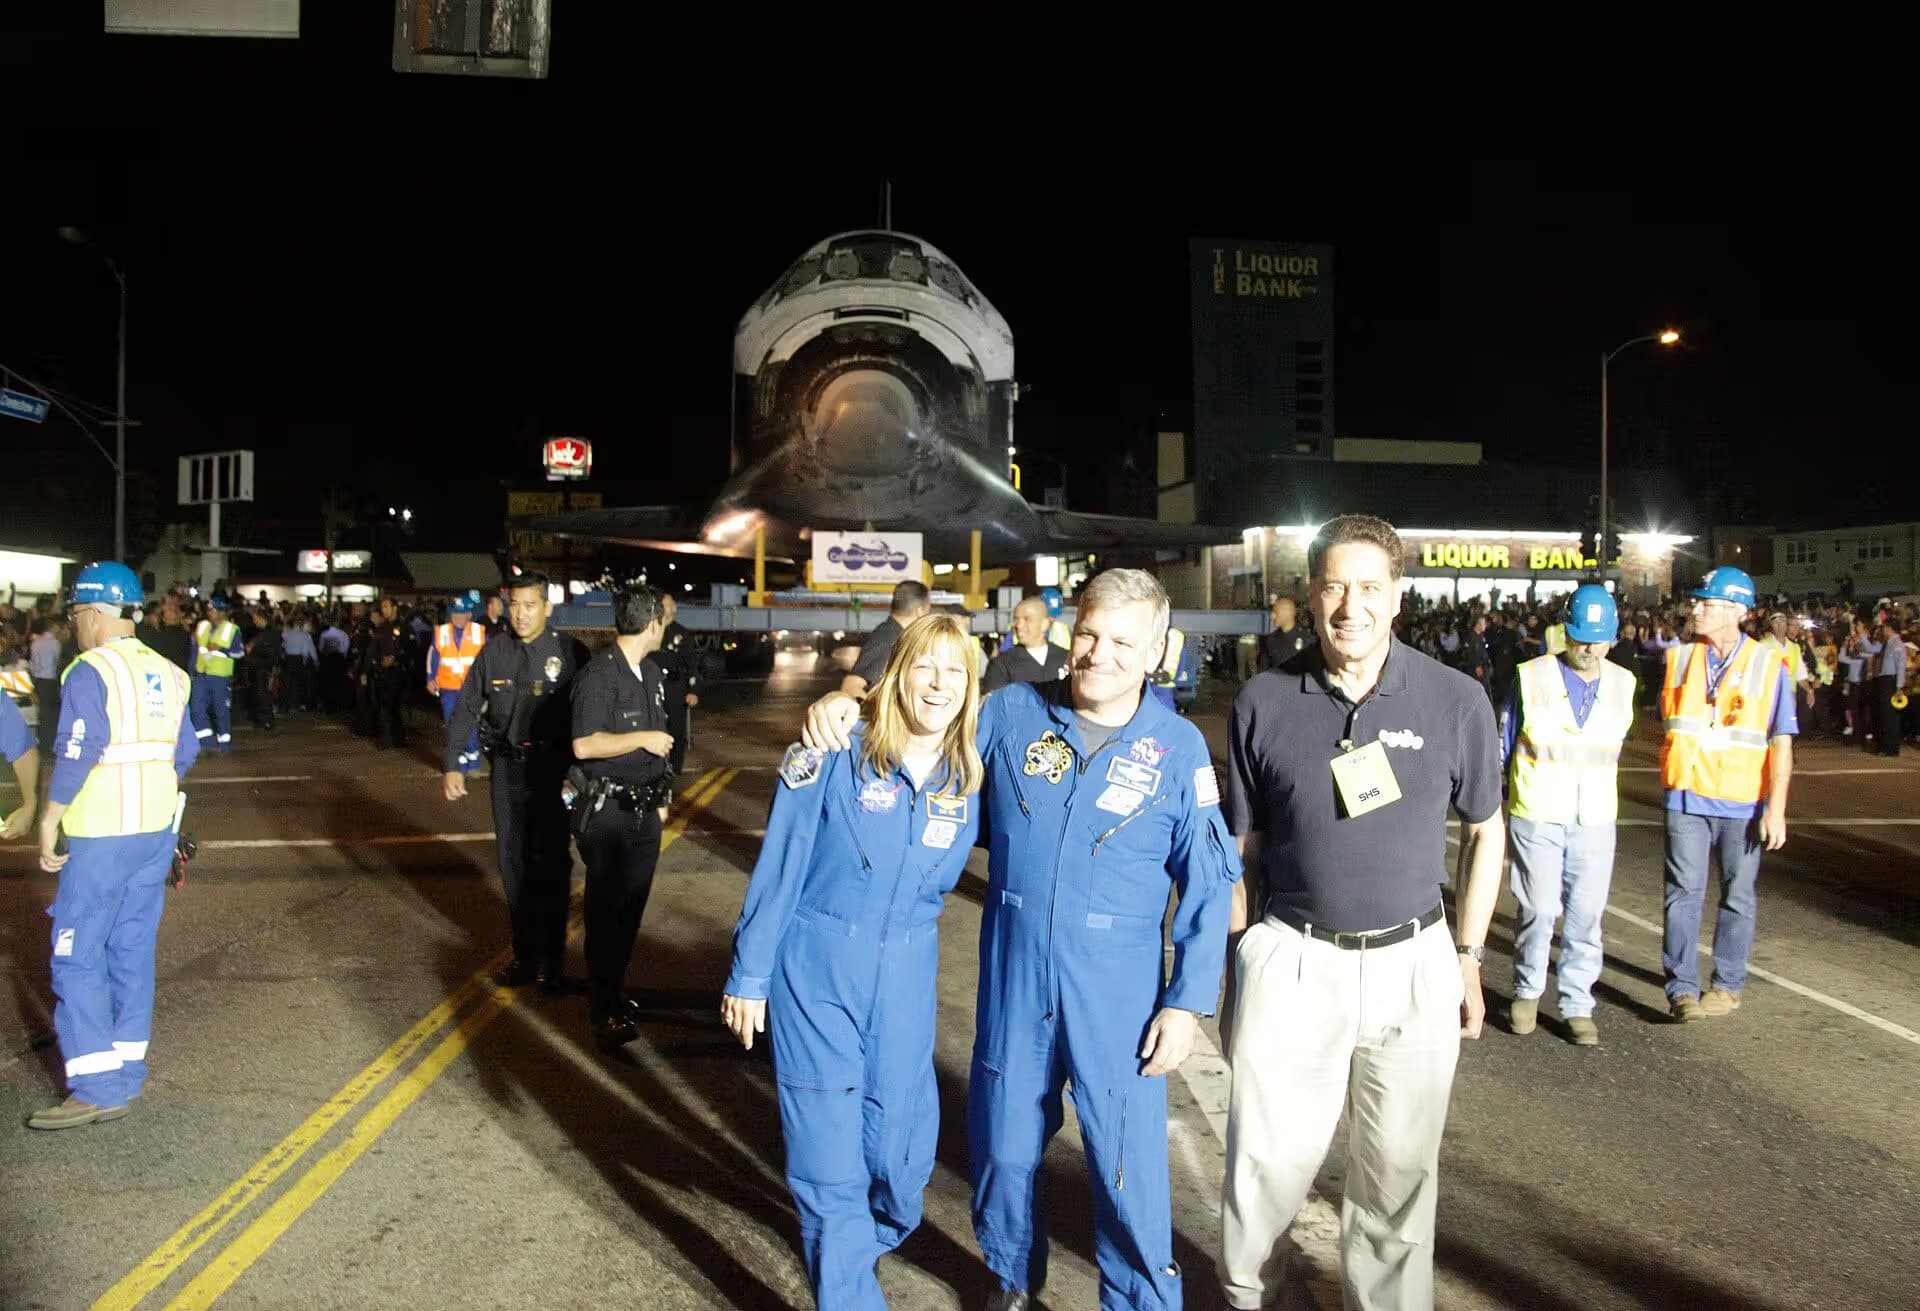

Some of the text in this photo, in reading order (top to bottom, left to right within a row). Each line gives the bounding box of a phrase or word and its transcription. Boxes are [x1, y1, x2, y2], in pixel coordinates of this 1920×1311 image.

[1213, 248, 1225, 294] THE
[1235, 249, 1319, 276] LIQUOR
[1236, 273, 1302, 298] BANK
[1423, 543, 1510, 569] LIQUOR
[1529, 546, 1597, 570] BAN
[1358, 787, 1381, 802] SHS
